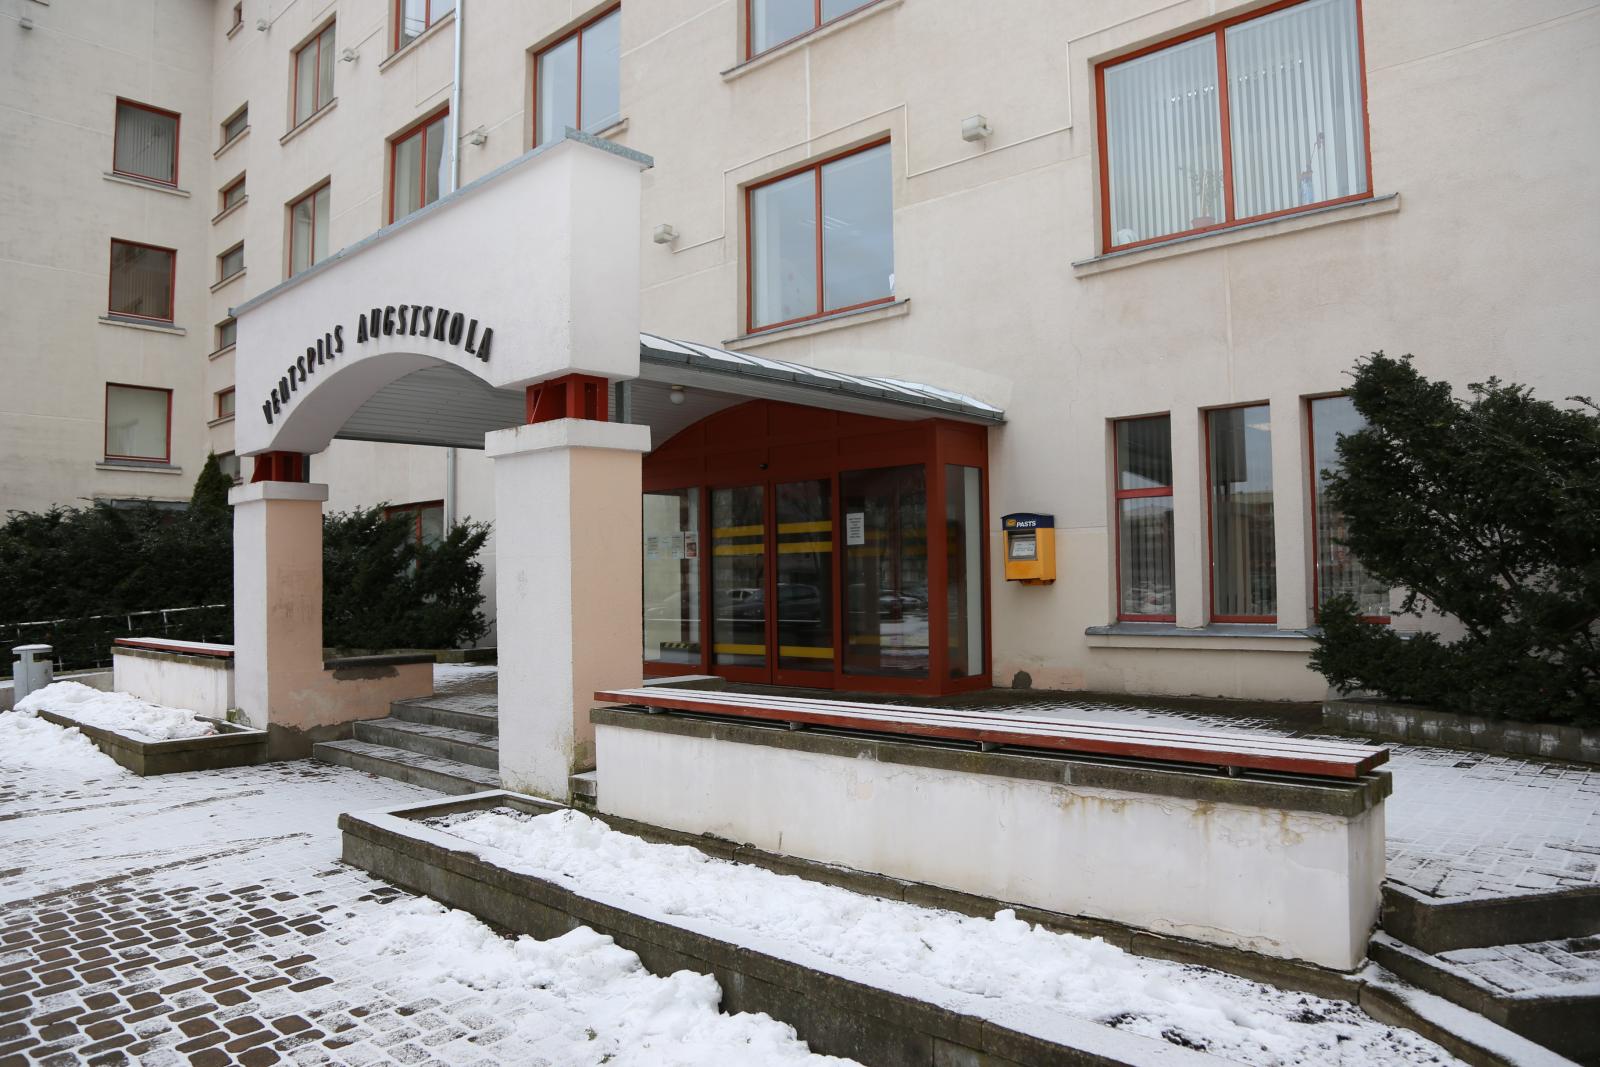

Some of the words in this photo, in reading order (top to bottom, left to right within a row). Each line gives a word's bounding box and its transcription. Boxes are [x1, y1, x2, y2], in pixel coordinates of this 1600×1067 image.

[262, 325, 344, 425] VENTSPILS
[357, 304, 494, 363] AUGSTSKOLA
[1016, 520, 1037, 528] PASTS
